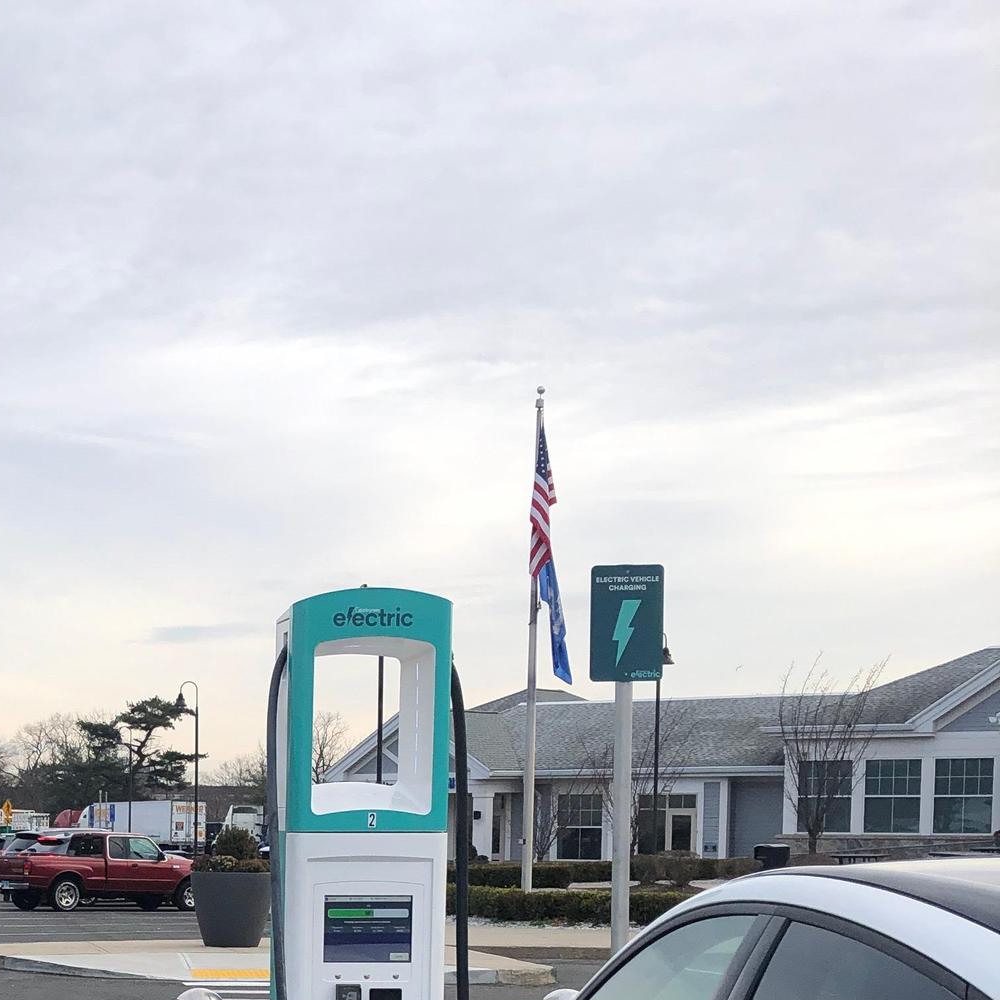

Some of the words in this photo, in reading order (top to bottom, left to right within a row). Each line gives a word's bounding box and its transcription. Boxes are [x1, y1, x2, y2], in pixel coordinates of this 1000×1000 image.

[333, 606, 414, 627] electric
[630, 669, 660, 678] electric
[175, 804, 204, 813] WERNR
[369, 814, 375, 827] 2
